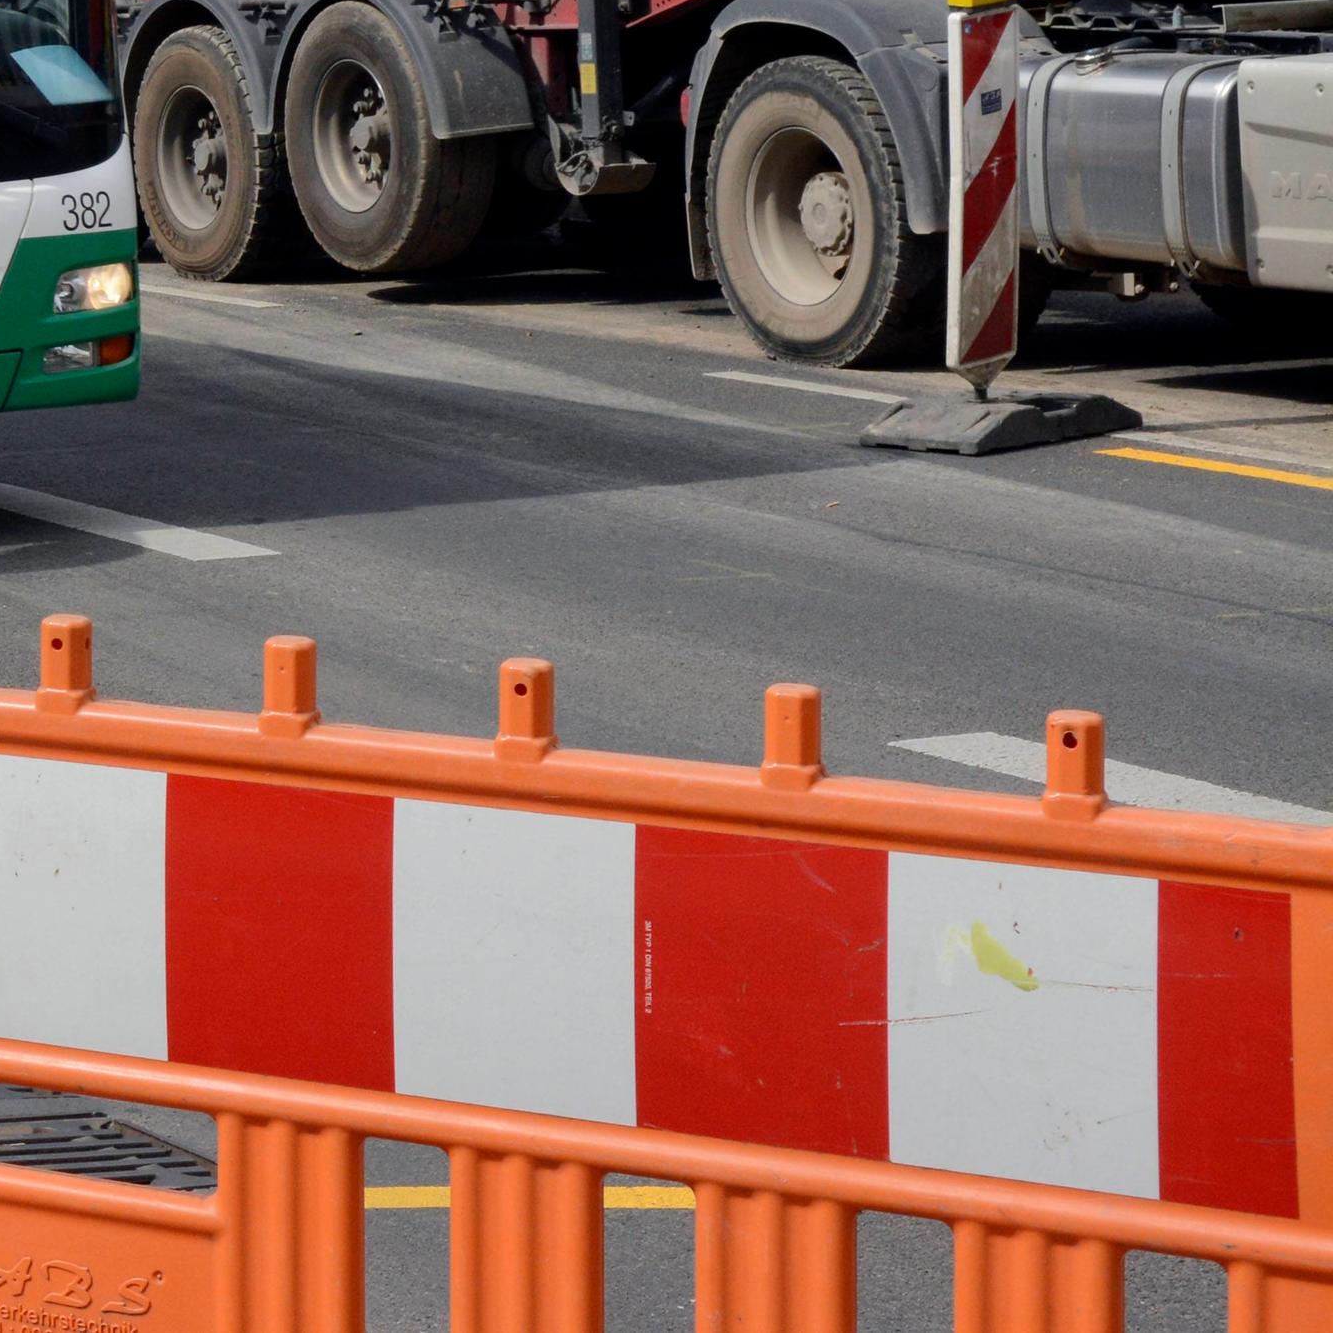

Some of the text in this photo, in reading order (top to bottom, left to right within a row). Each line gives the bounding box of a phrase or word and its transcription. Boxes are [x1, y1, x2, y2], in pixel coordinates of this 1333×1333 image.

[61, 191, 112, 231] 382
[644, 933, 652, 947] TYP
[644, 954, 652, 967] DIN
